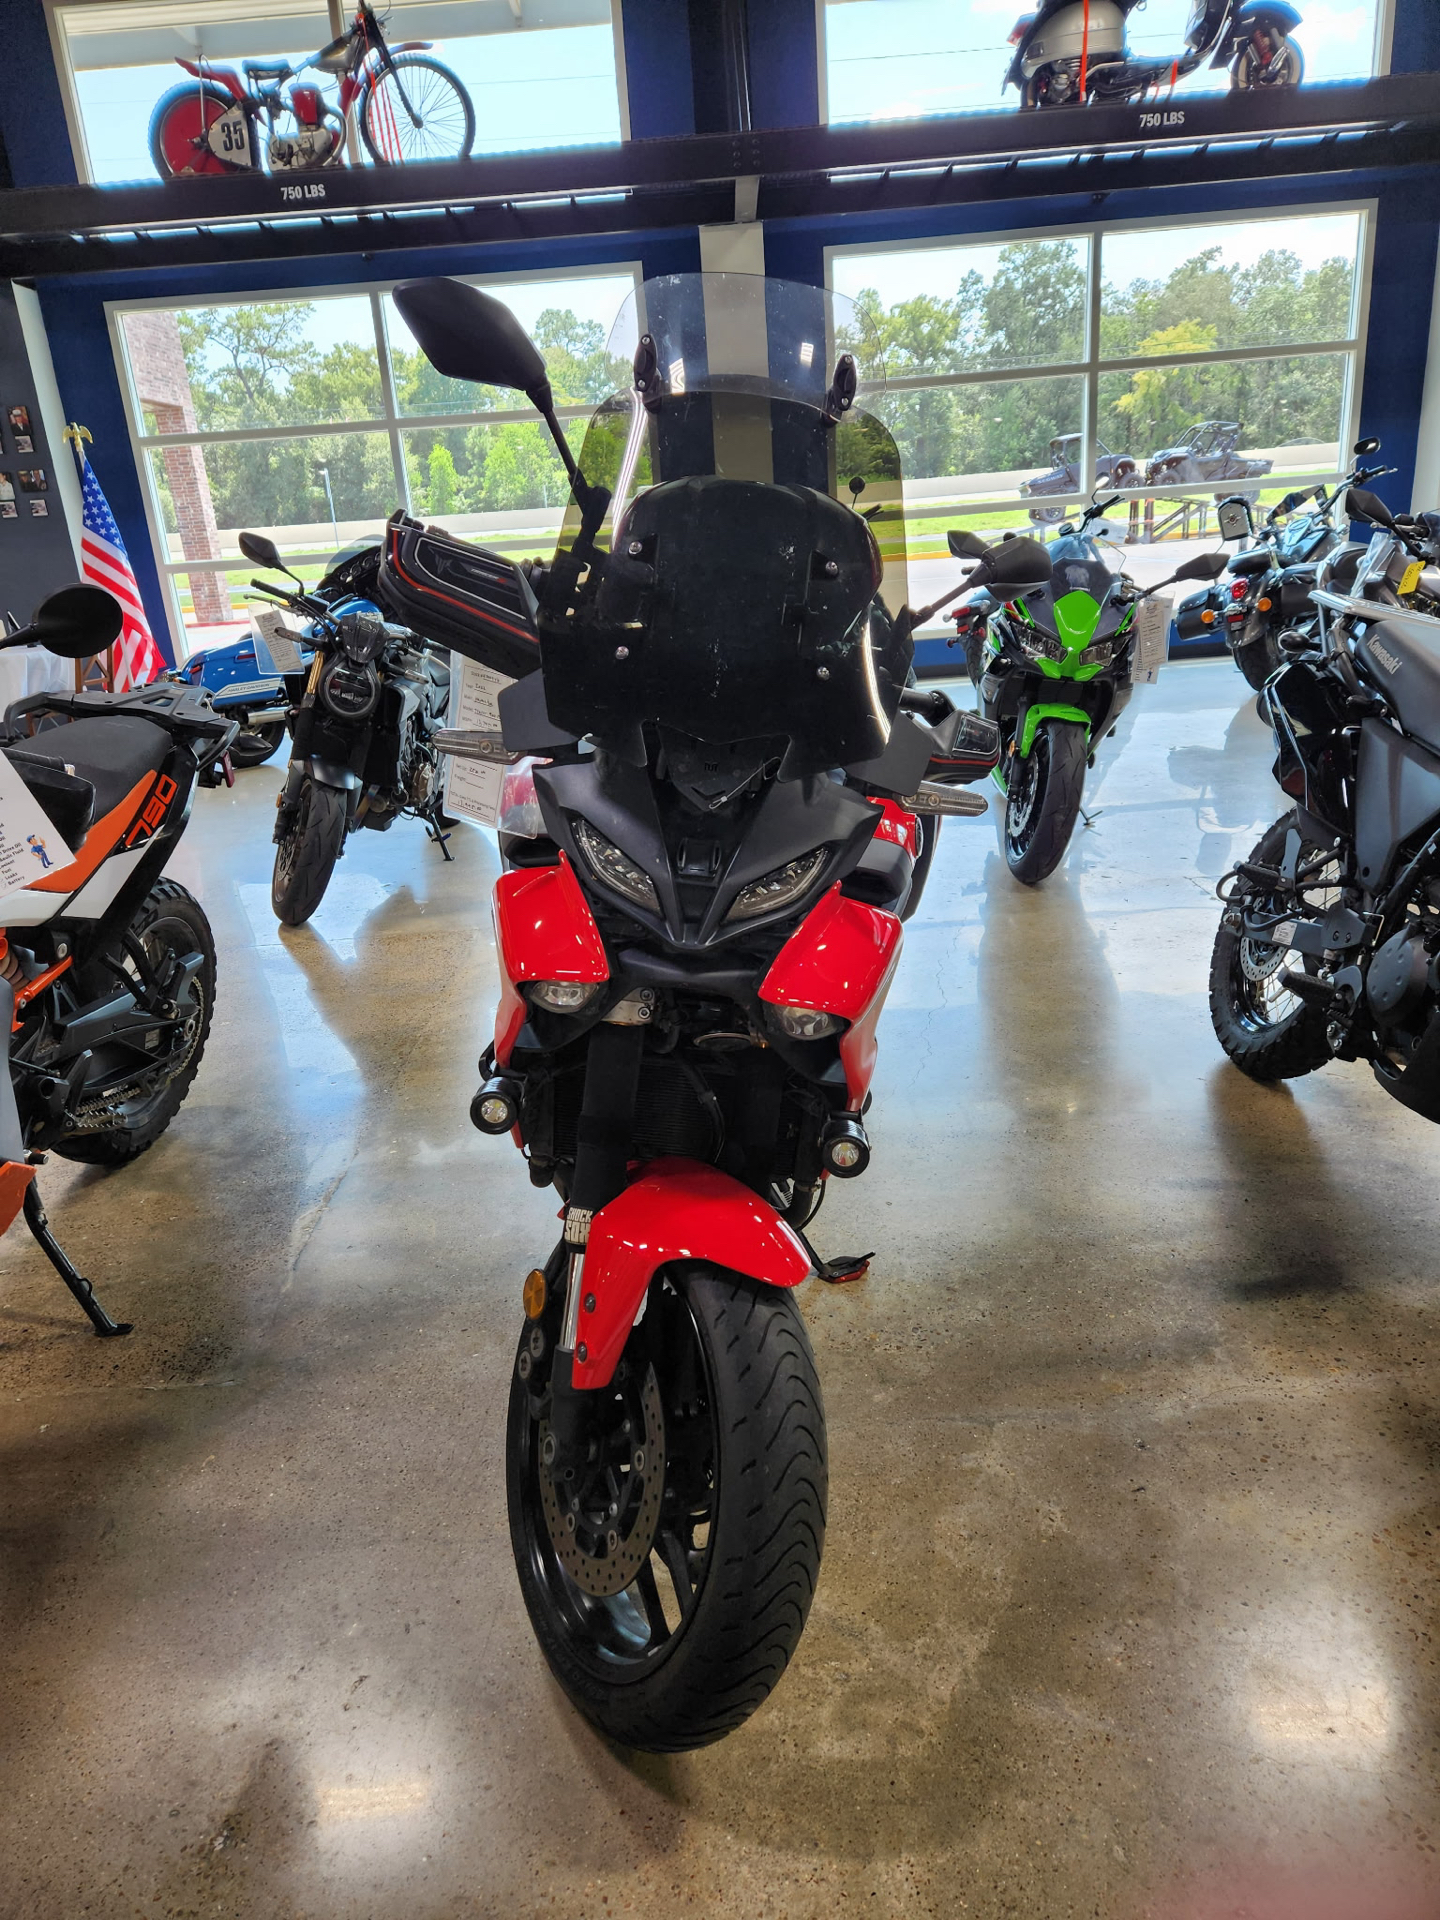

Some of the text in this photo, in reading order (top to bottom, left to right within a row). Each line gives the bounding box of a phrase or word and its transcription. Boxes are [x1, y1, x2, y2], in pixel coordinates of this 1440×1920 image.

[1139, 111, 1185, 128] 750 LBS
[221, 120, 246, 152] 35
[280, 183, 326, 201] 750 LBS
[1366, 633, 1403, 675] Kawasaki
[125, 773, 178, 848] 790
[566, 1206, 594, 1223] SHOCK
[564, 1220, 591, 1244] SOX
